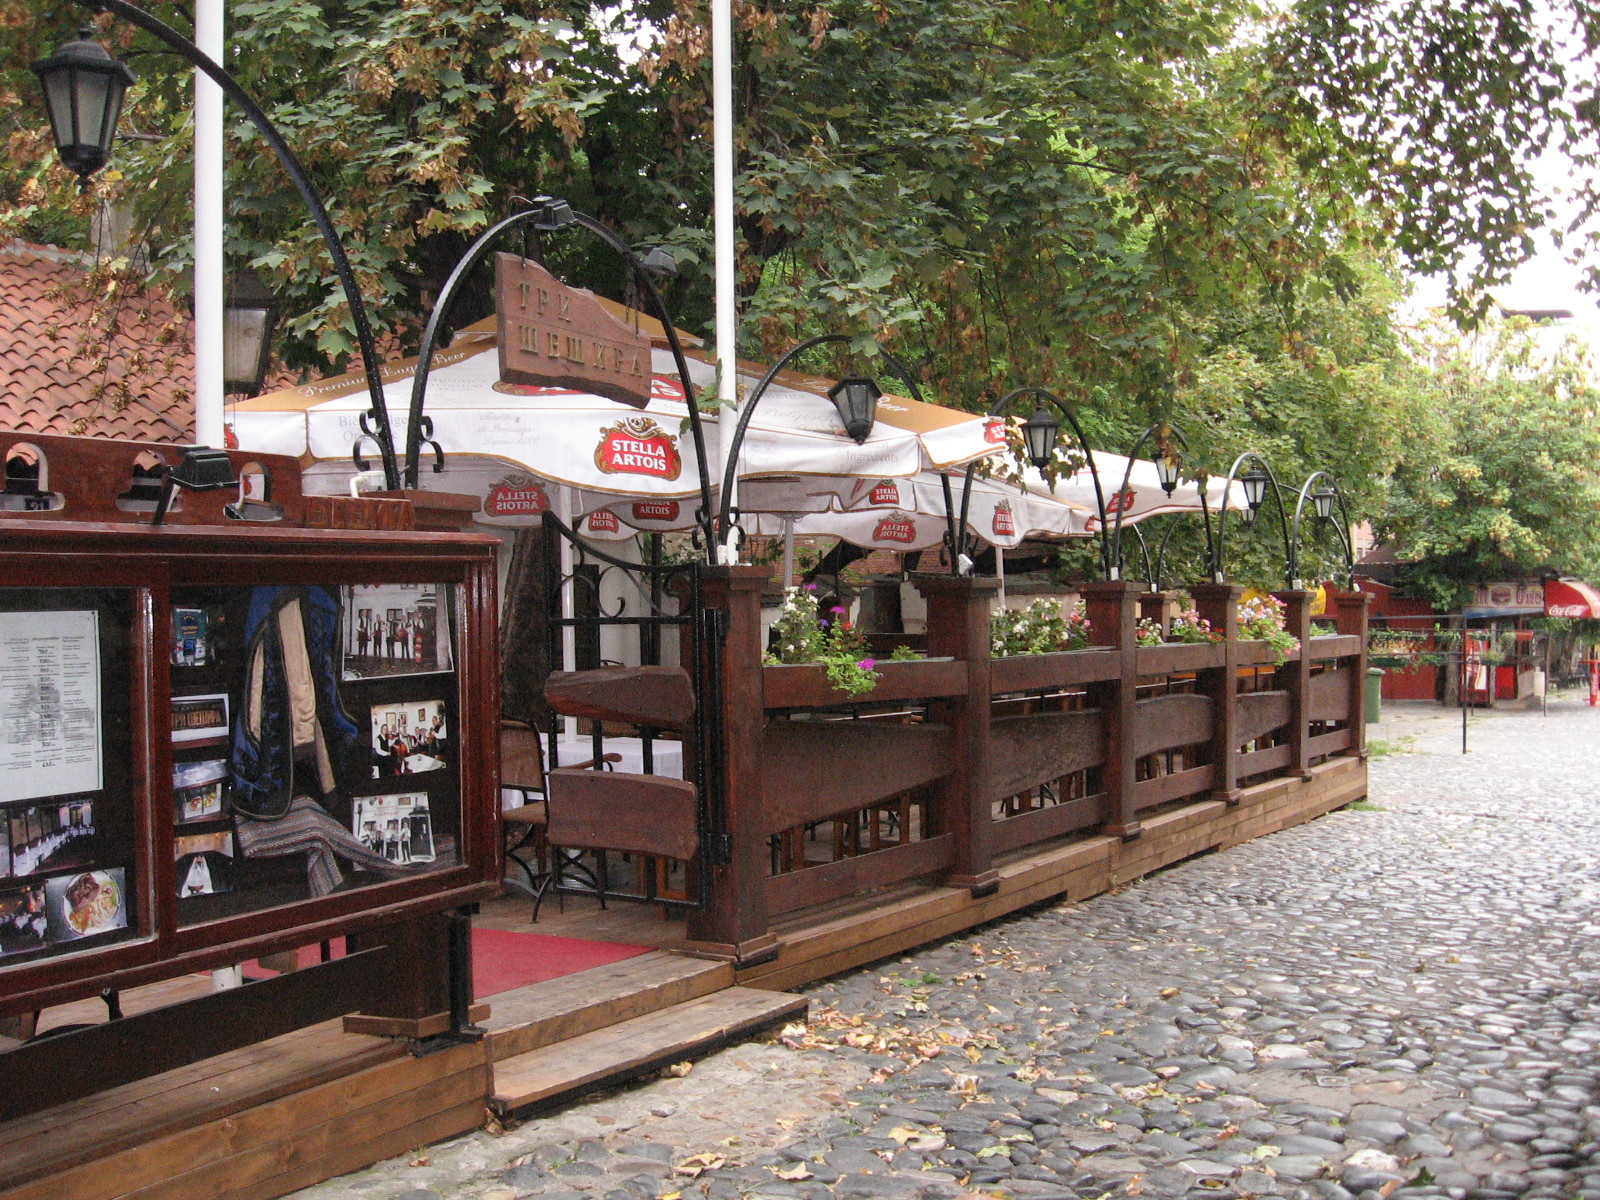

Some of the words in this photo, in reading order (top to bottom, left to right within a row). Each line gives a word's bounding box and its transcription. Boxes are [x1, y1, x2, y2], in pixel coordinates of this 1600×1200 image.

[518, 283, 572, 322] ТРИ
[431, 352, 466, 366] Beer
[519, 325, 643, 377] ШЕШИРА
[611, 439, 666, 458] STELLA
[611, 452, 667, 471] ARTOIS
[640, 506, 670, 515] ARTOIS
